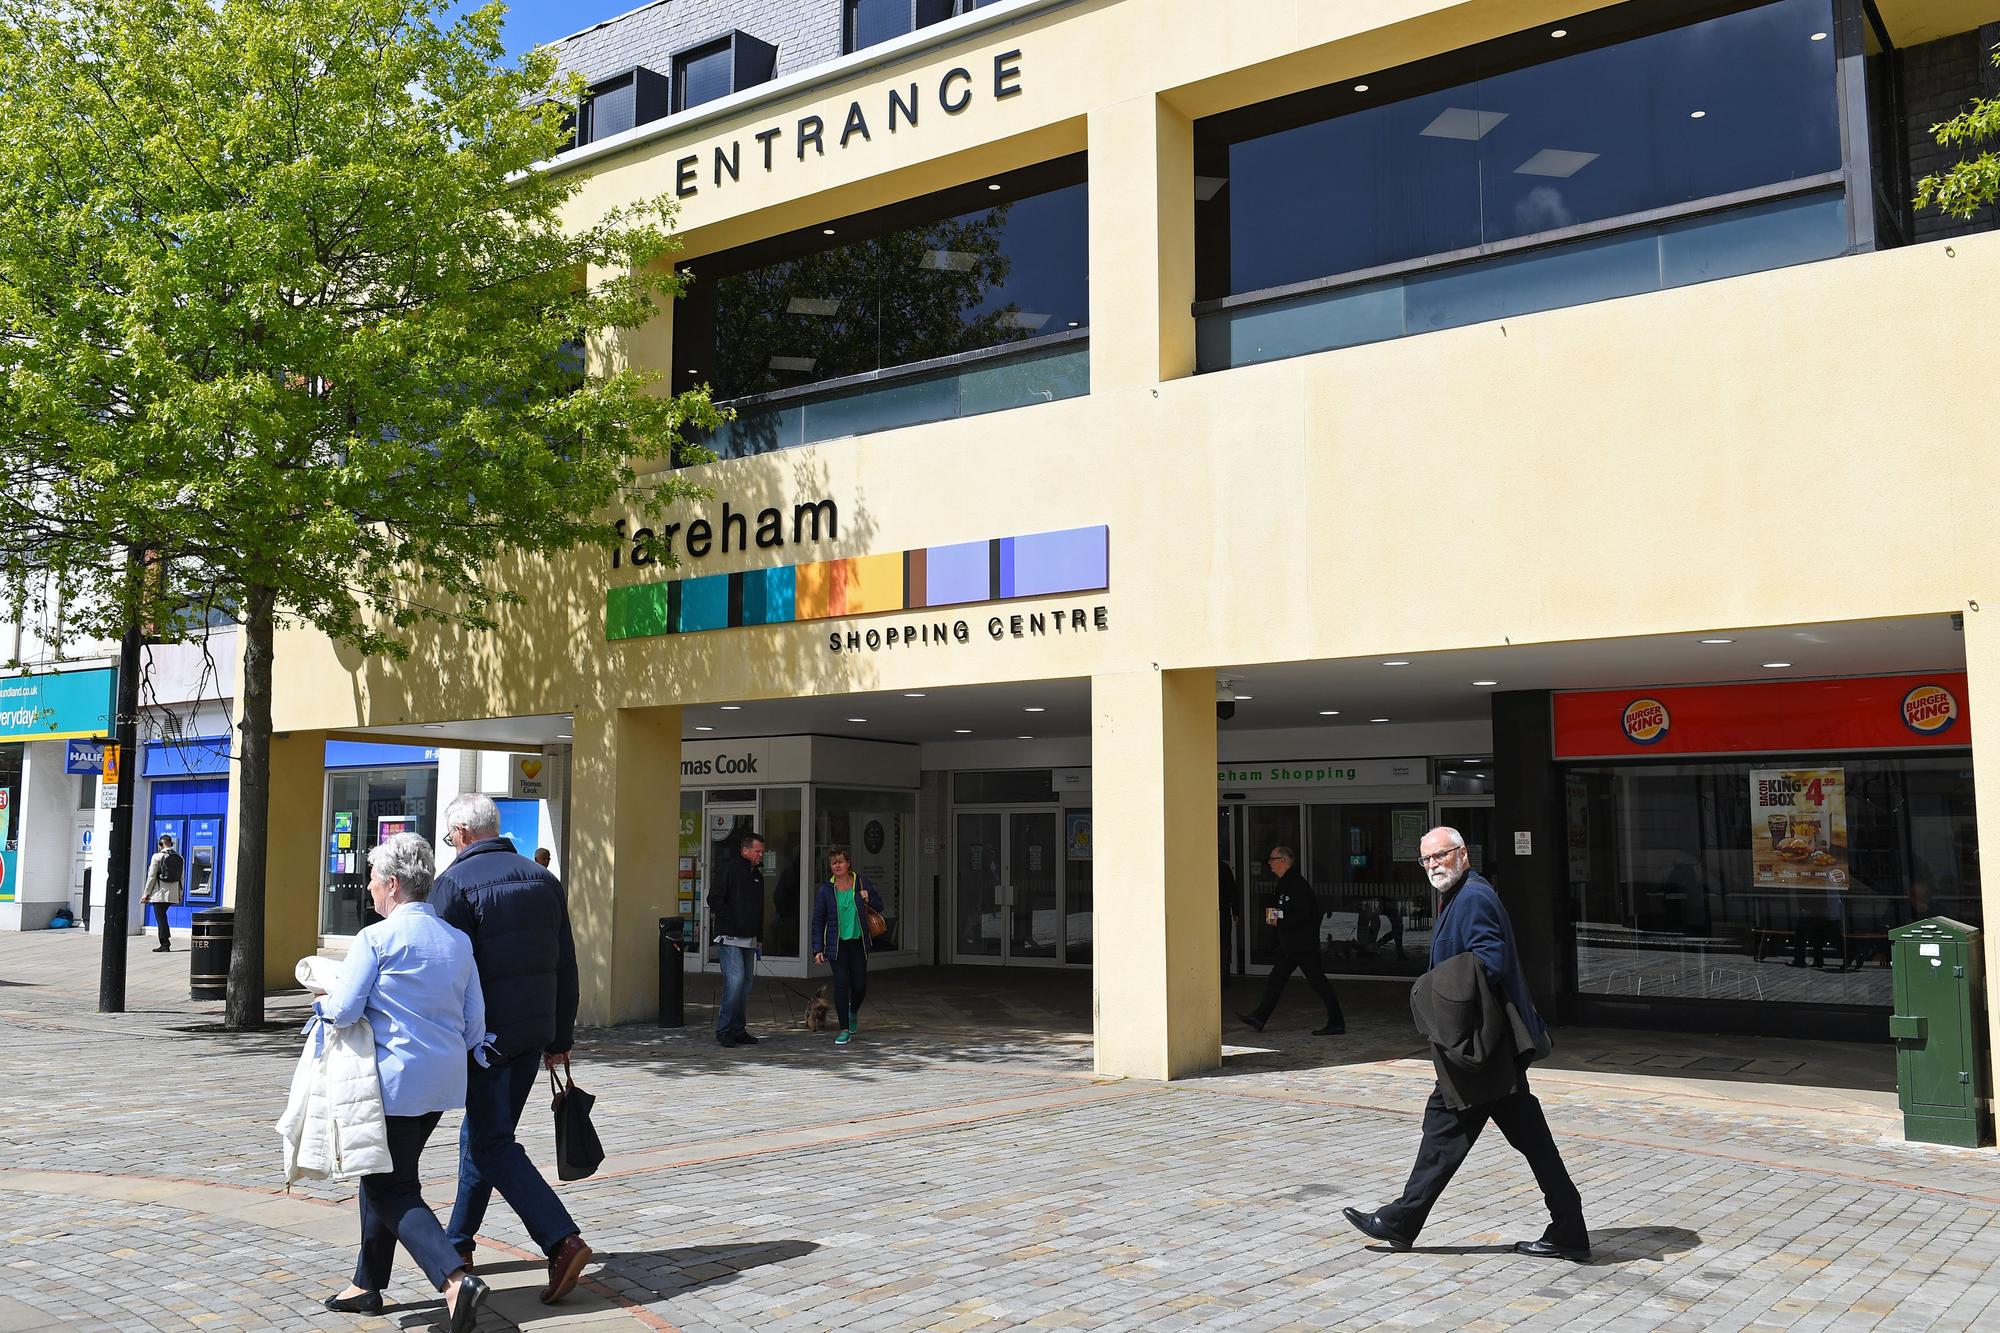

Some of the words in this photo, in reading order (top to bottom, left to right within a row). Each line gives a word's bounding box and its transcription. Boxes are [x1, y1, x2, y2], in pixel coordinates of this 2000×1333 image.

[676, 49, 1022, 196] ENTRANCE
[612, 499, 838, 569] fareham
[829, 620, 969, 651] SHOPPING
[988, 606, 1107, 638] CENTRE
[1907, 693, 1948, 712] BURGER
[1908, 702, 1950, 724] KING
[1626, 706, 1661, 724] BURGER
[1628, 714, 1663, 735] KING
[715, 753, 758, 774] Cook
[1217, 769, 1263, 781] eham
[1271, 766, 1356, 782] Shopping
[523, 786, 538, 794] Cook
[1759, 779, 1769, 807] BACON
[1768, 779, 1802, 793] KING
[1769, 793, 1795, 806] BOX
